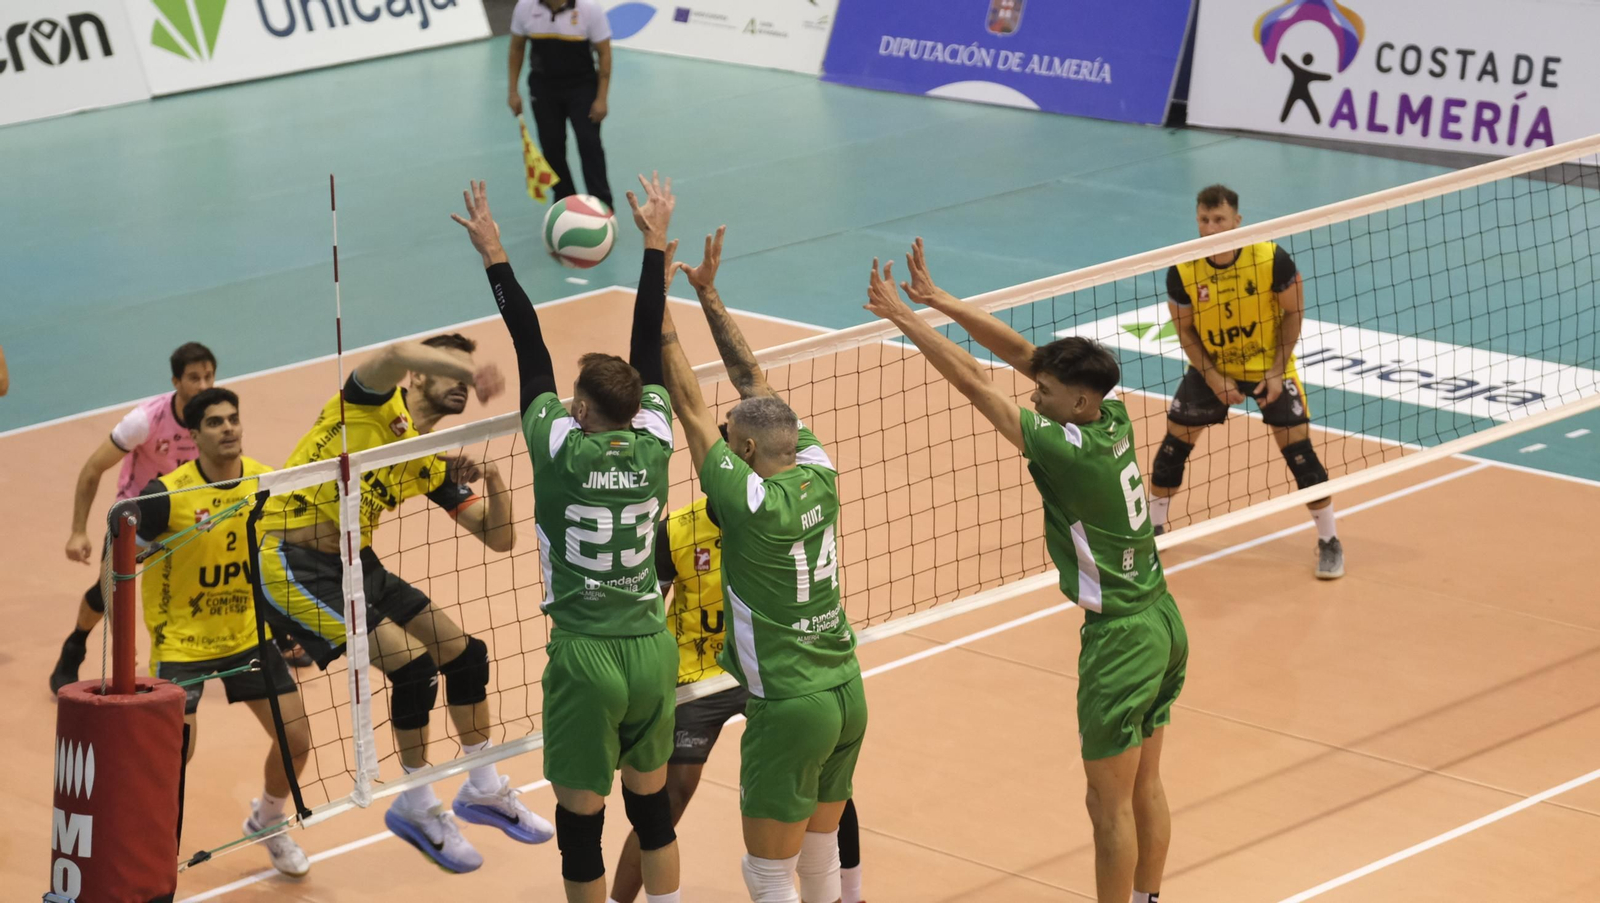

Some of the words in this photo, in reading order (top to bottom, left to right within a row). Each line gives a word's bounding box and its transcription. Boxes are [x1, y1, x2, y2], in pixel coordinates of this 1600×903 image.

[0, 12, 113, 73] ron
[878, 35, 995, 68] DIPUTACIÓN
[997, 49, 1026, 73] DE
[1025, 56, 1113, 84] ALMERÍA
[1375, 42, 1499, 83] COSTA
[1511, 53, 1561, 89] DE
[1329, 88, 1555, 148] ALMERÍA
[1224, 302, 1233, 319] 5
[1207, 320, 1257, 347] UPV
[1284, 378, 1298, 396] 5
[582, 467, 649, 489] JIMÉNEZ
[1119, 461, 1148, 531] 6
[564, 497, 660, 571] 23
[800, 504, 825, 531] RUIZ
[226, 531, 236, 551] 2
[199, 559, 252, 588] UPV
[788, 524, 838, 602] 14
